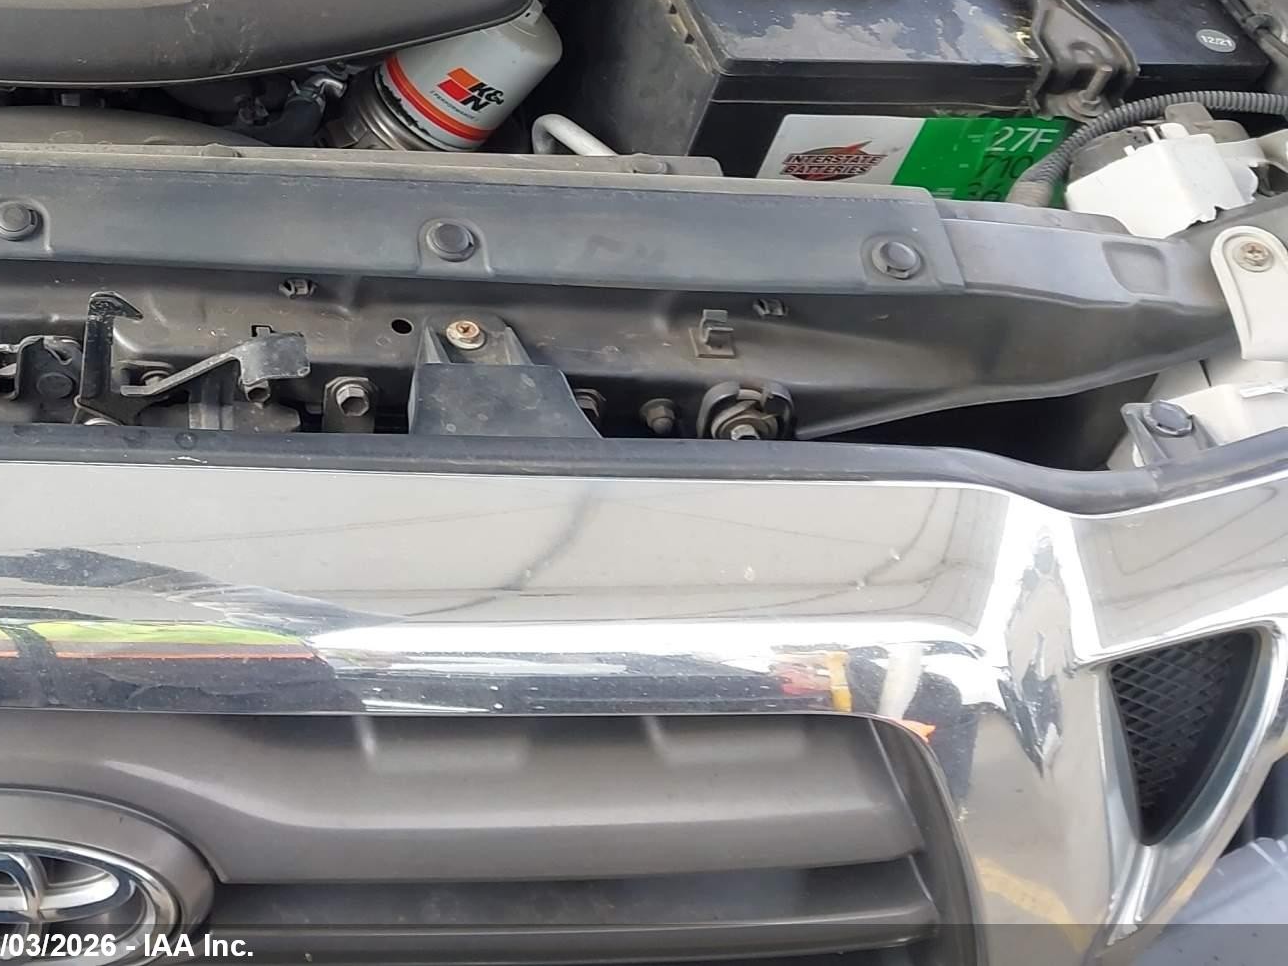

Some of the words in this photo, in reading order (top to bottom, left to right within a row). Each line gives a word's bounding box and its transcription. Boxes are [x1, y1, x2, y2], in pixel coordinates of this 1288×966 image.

[985, 126, 1060, 153] 27F
[785, 154, 882, 165] INTERSTATE
[972, 154, 1034, 180] 710
[784, 165, 869, 175] BATTERIES
